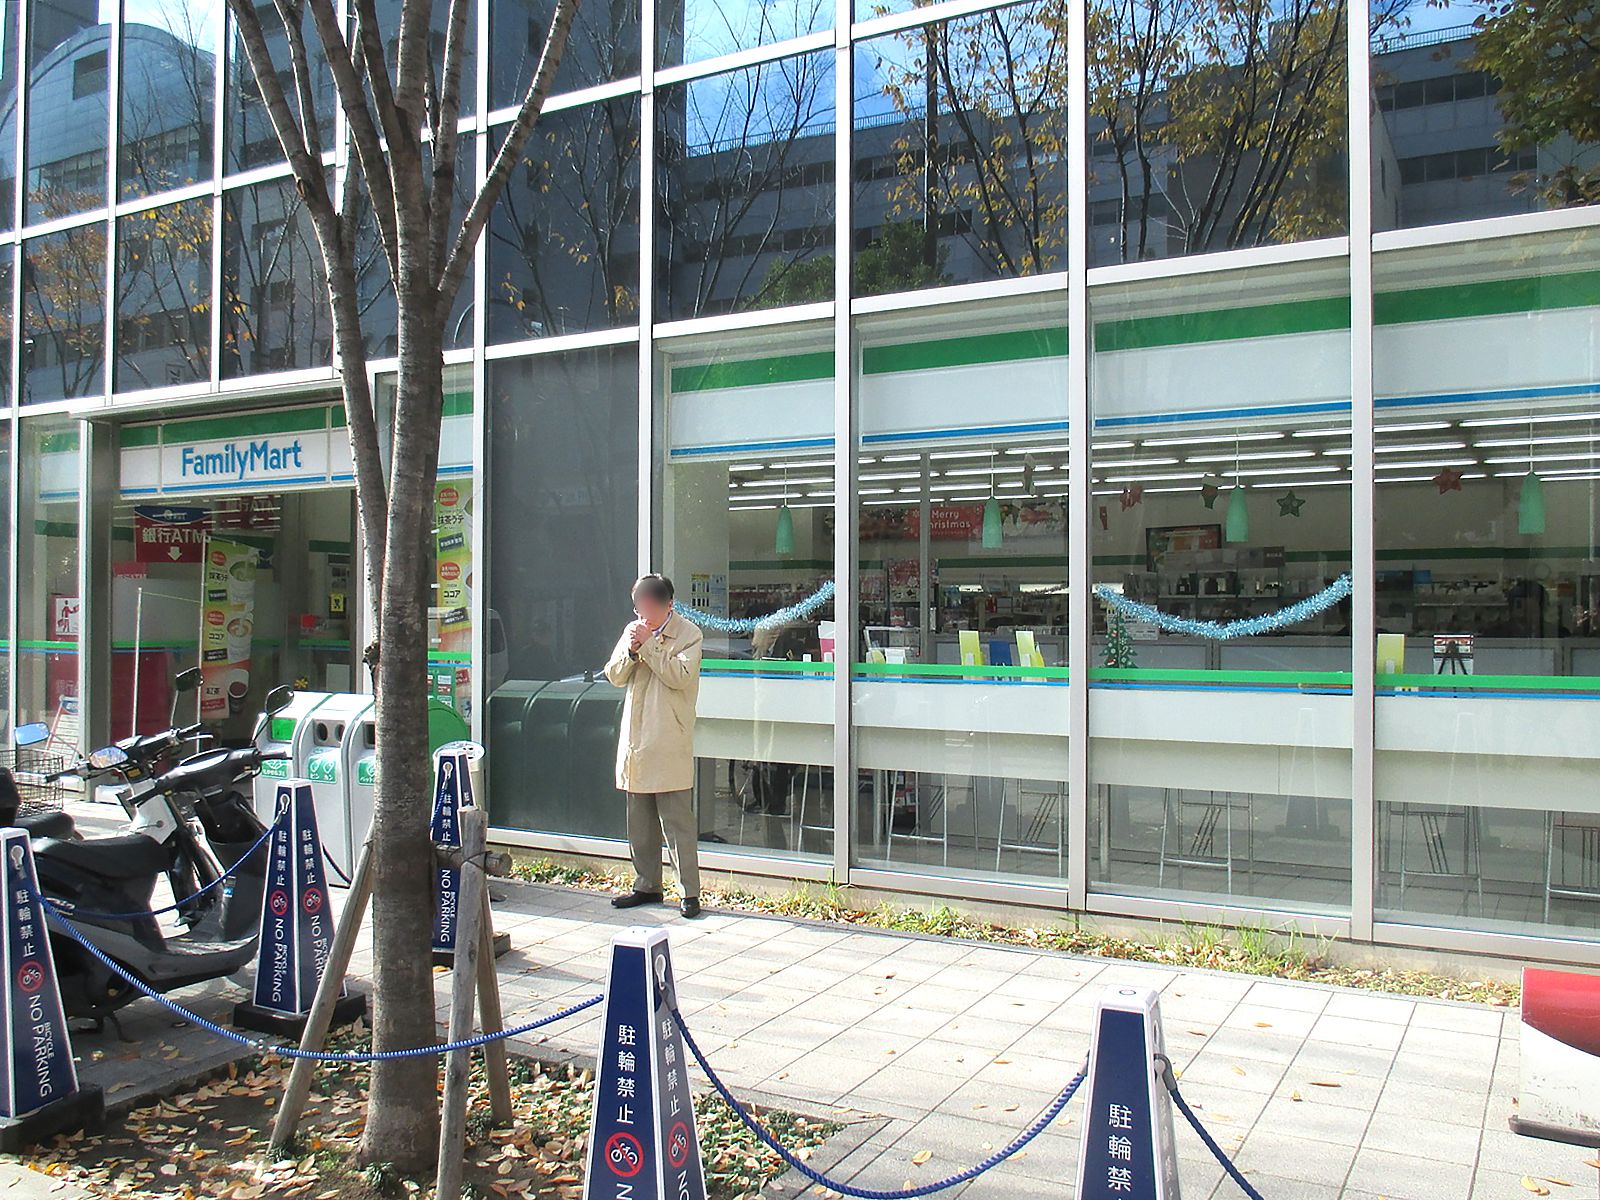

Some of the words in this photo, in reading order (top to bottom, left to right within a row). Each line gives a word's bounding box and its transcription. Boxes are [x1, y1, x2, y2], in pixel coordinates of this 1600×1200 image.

[182, 440, 302, 480] FamilyMart
[930, 520, 971, 529] hristmas
[931, 510, 960, 519] Merry
[142, 528, 206, 544] 銀行ATM
[443, 589, 461, 598] ココア
[276, 830, 287, 886] 駐輪禁止
[302, 829, 316, 885] 駐輪禁止
[440, 869, 451, 889] NO
[16, 890, 36, 958] 駐輪禁止
[274, 918, 284, 940] NO
[311, 915, 322, 937] NO
[440, 891, 450, 943] PARKING
[272, 942, 284, 1002] PARKING
[312, 939, 324, 981] PARKI
[29, 994, 43, 1021] NO
[32, 1023, 53, 1098] PARKING
[44, 1022, 55, 1059] BICYCLE
[617, 1024, 636, 1125] 駐輪禁止
[661, 1018, 681, 1118] 駐輪禁止
[1107, 1103, 1133, 1200] 駐輪禁
